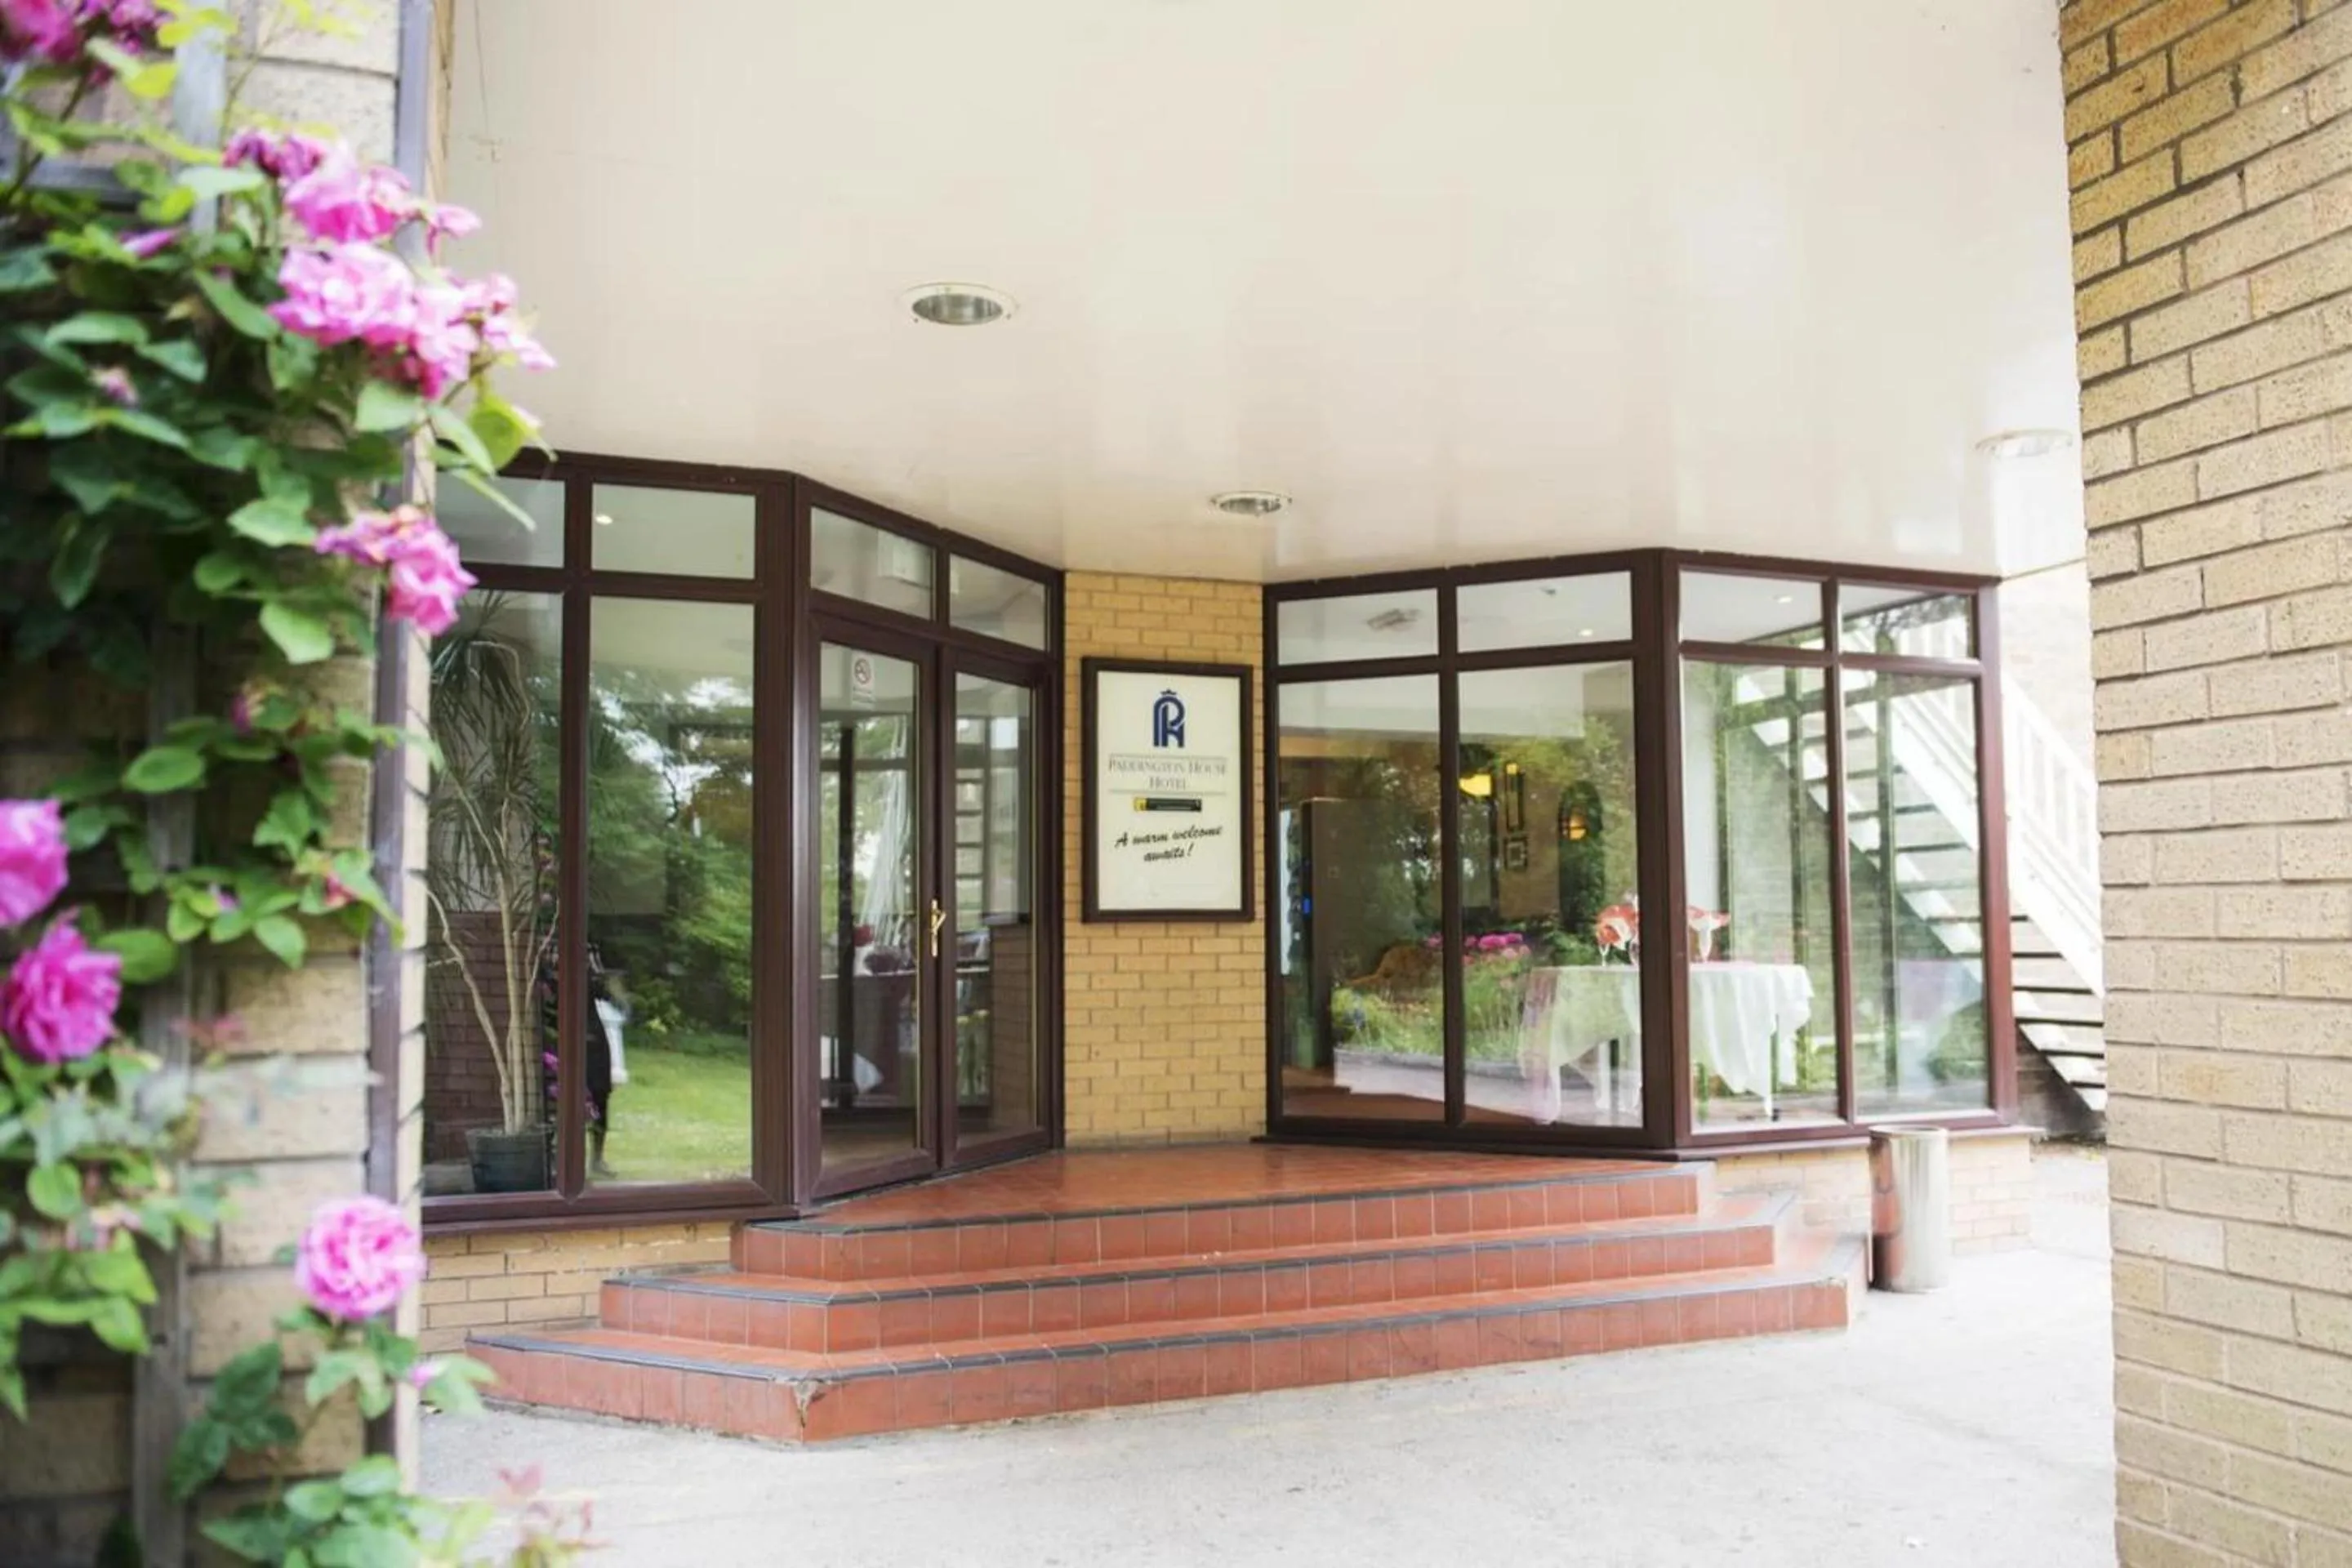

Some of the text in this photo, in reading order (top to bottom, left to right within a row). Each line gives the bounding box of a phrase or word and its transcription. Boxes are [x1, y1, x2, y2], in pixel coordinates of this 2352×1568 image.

[1149, 776, 1186, 790] HOTEL
[1114, 824, 1223, 848] A warm welcome
